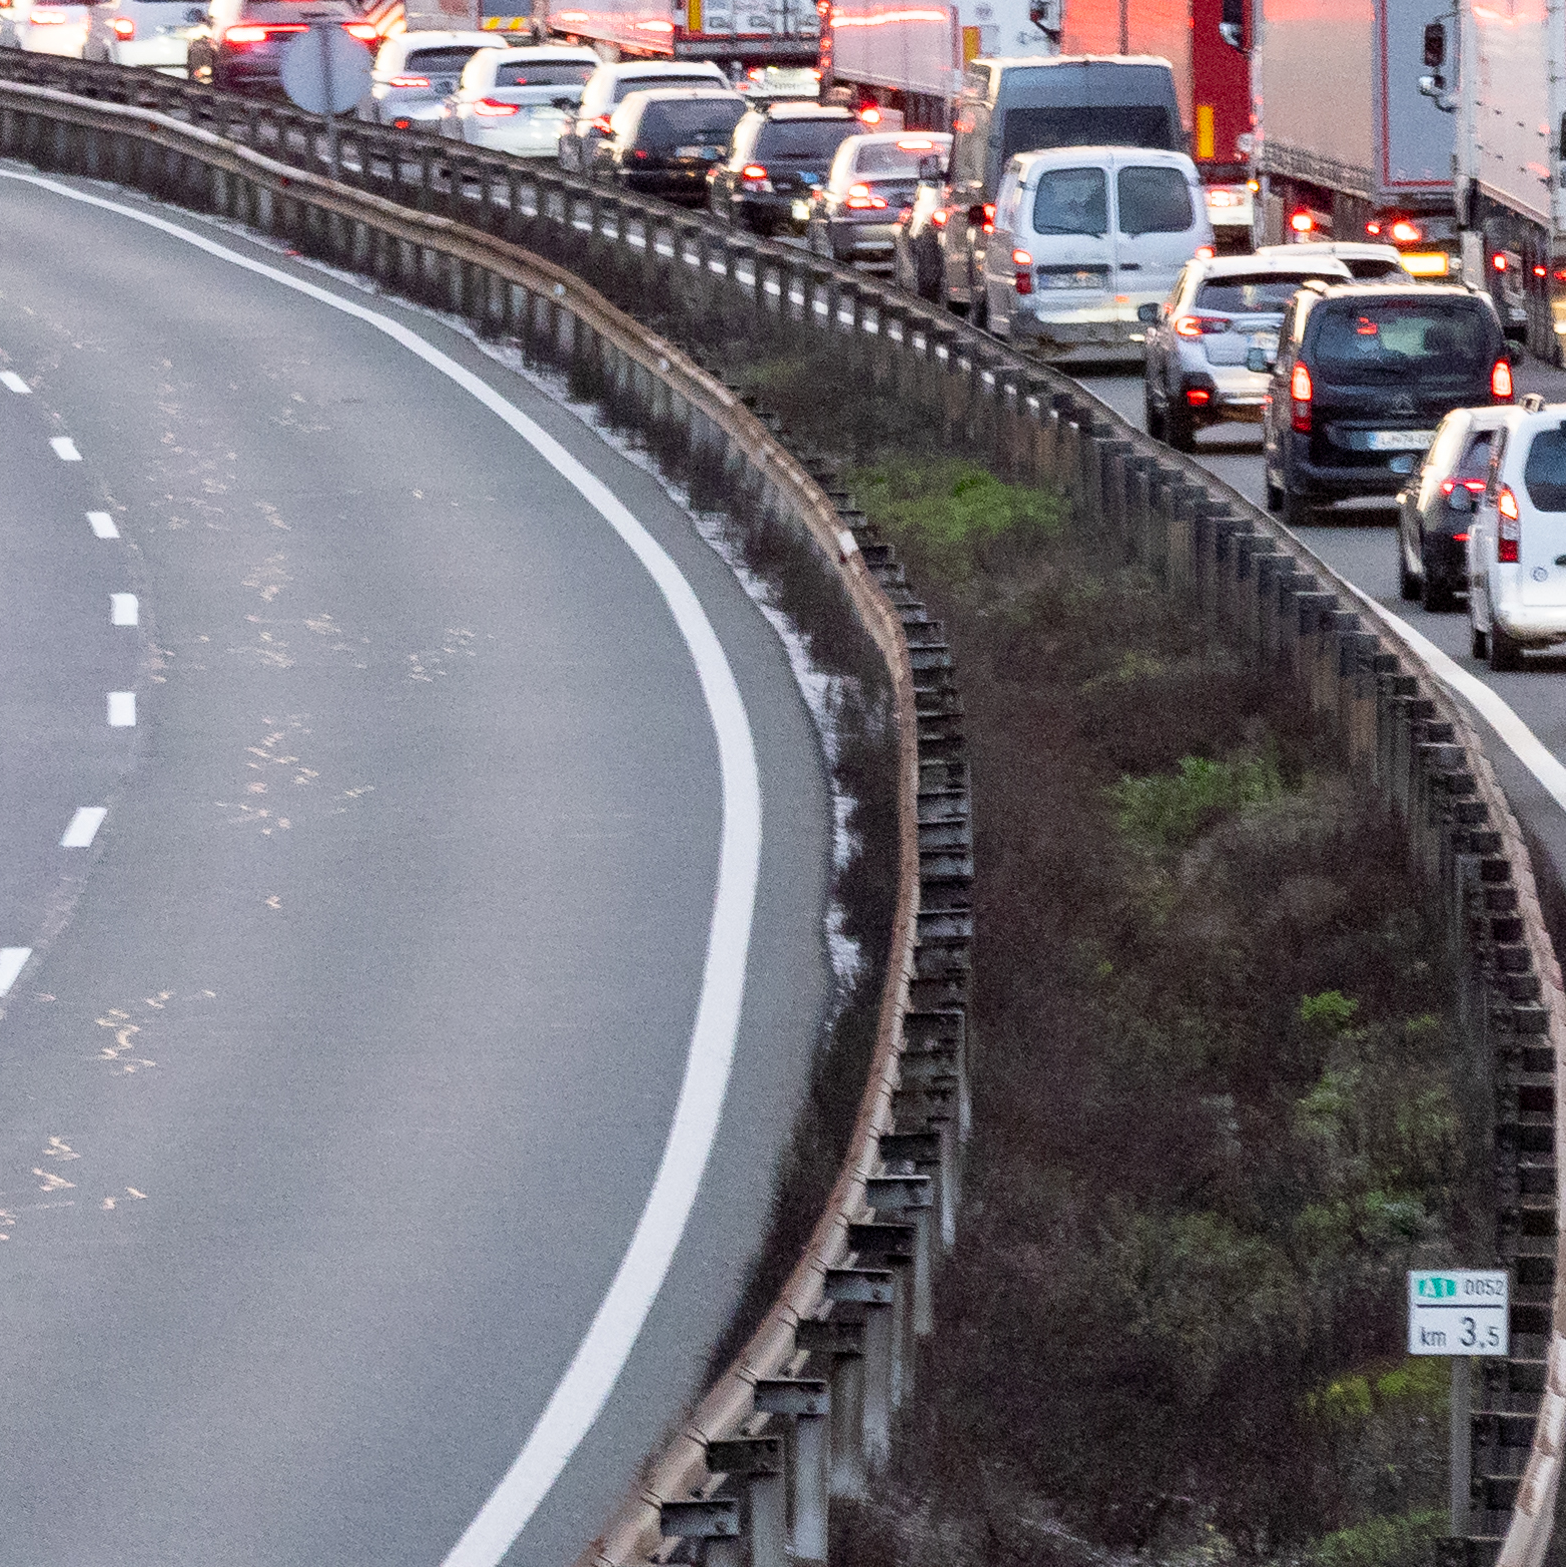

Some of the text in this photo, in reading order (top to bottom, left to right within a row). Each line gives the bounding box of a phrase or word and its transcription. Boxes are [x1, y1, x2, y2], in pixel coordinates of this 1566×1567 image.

[1422, 1278, 1504, 1298] A1 0052
[1420, 1326, 1447, 1347] km
